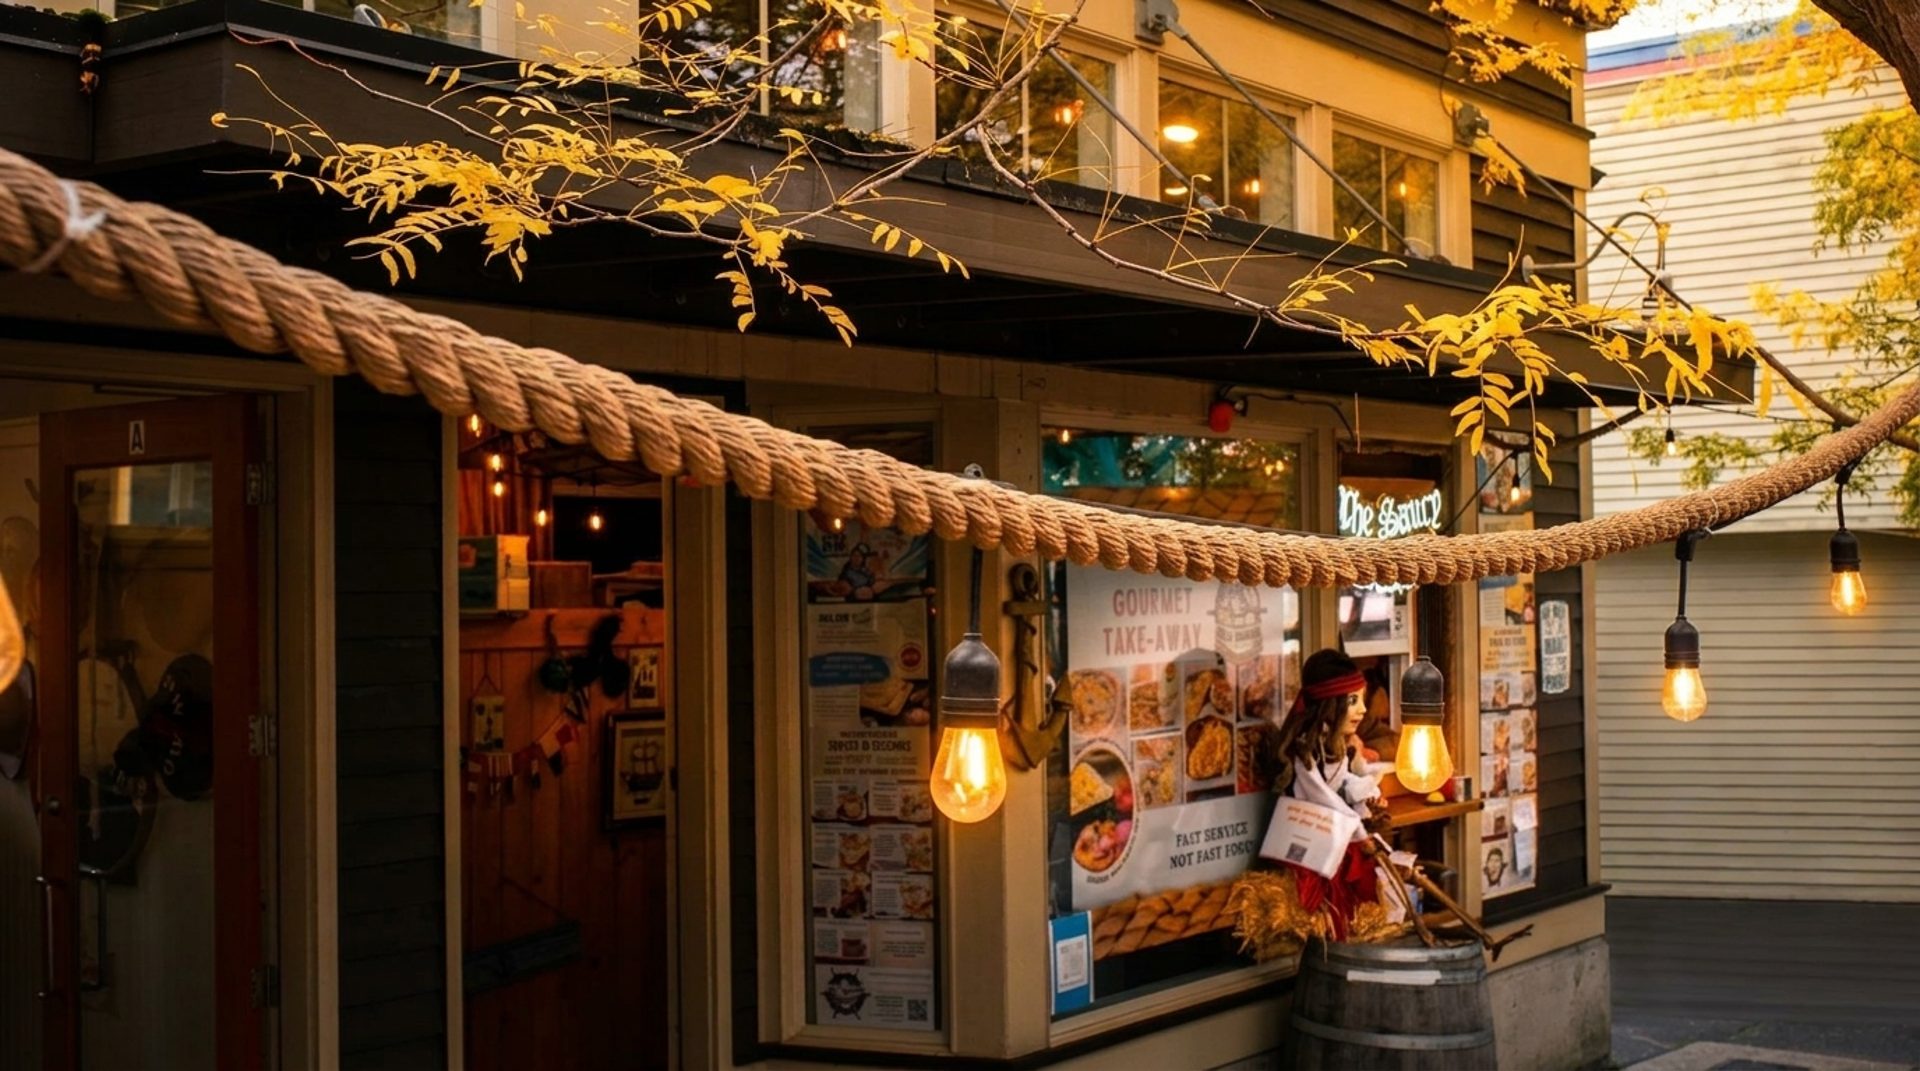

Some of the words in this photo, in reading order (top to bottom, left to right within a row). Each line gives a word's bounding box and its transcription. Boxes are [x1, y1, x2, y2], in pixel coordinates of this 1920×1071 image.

[131, 423, 143, 451] A
[1338, 484, 1373, 537] The
[1378, 488, 1441, 539] Saucy
[1112, 587, 1192, 617] GOURMET
[1102, 623, 1202, 656] TAKE-AWAY
[1176, 830, 1202, 847] FAST
[1204, 821, 1248, 842] SERVICE
[1169, 852, 1194, 869] NOT
[1197, 846, 1222, 864] FAST
